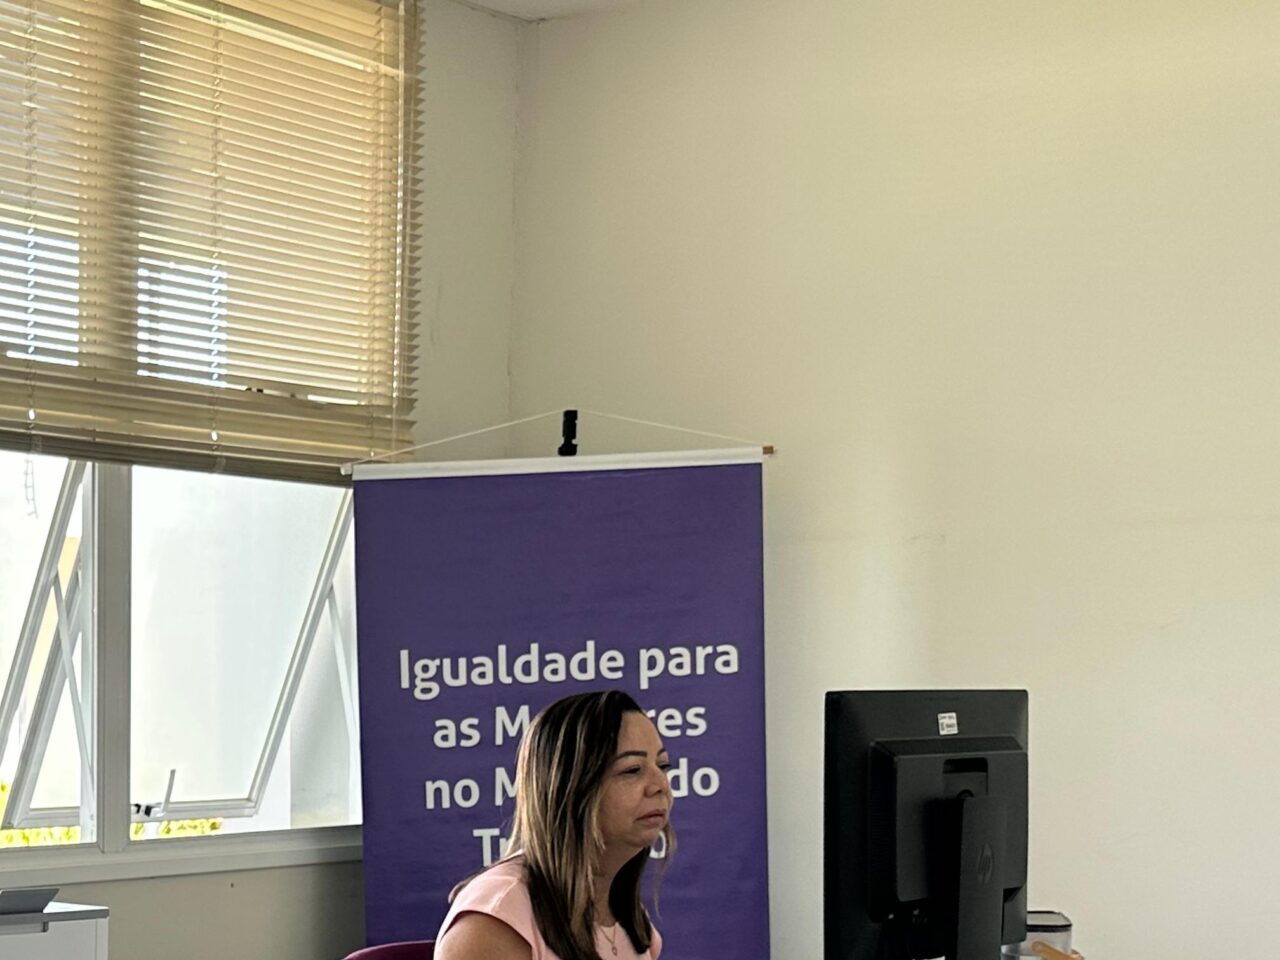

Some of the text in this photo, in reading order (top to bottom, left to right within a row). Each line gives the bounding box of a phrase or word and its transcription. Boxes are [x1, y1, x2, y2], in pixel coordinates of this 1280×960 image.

[400, 640, 740, 701] Igualdade para
[433, 716, 482, 749] as
[424, 777, 480, 810] no
